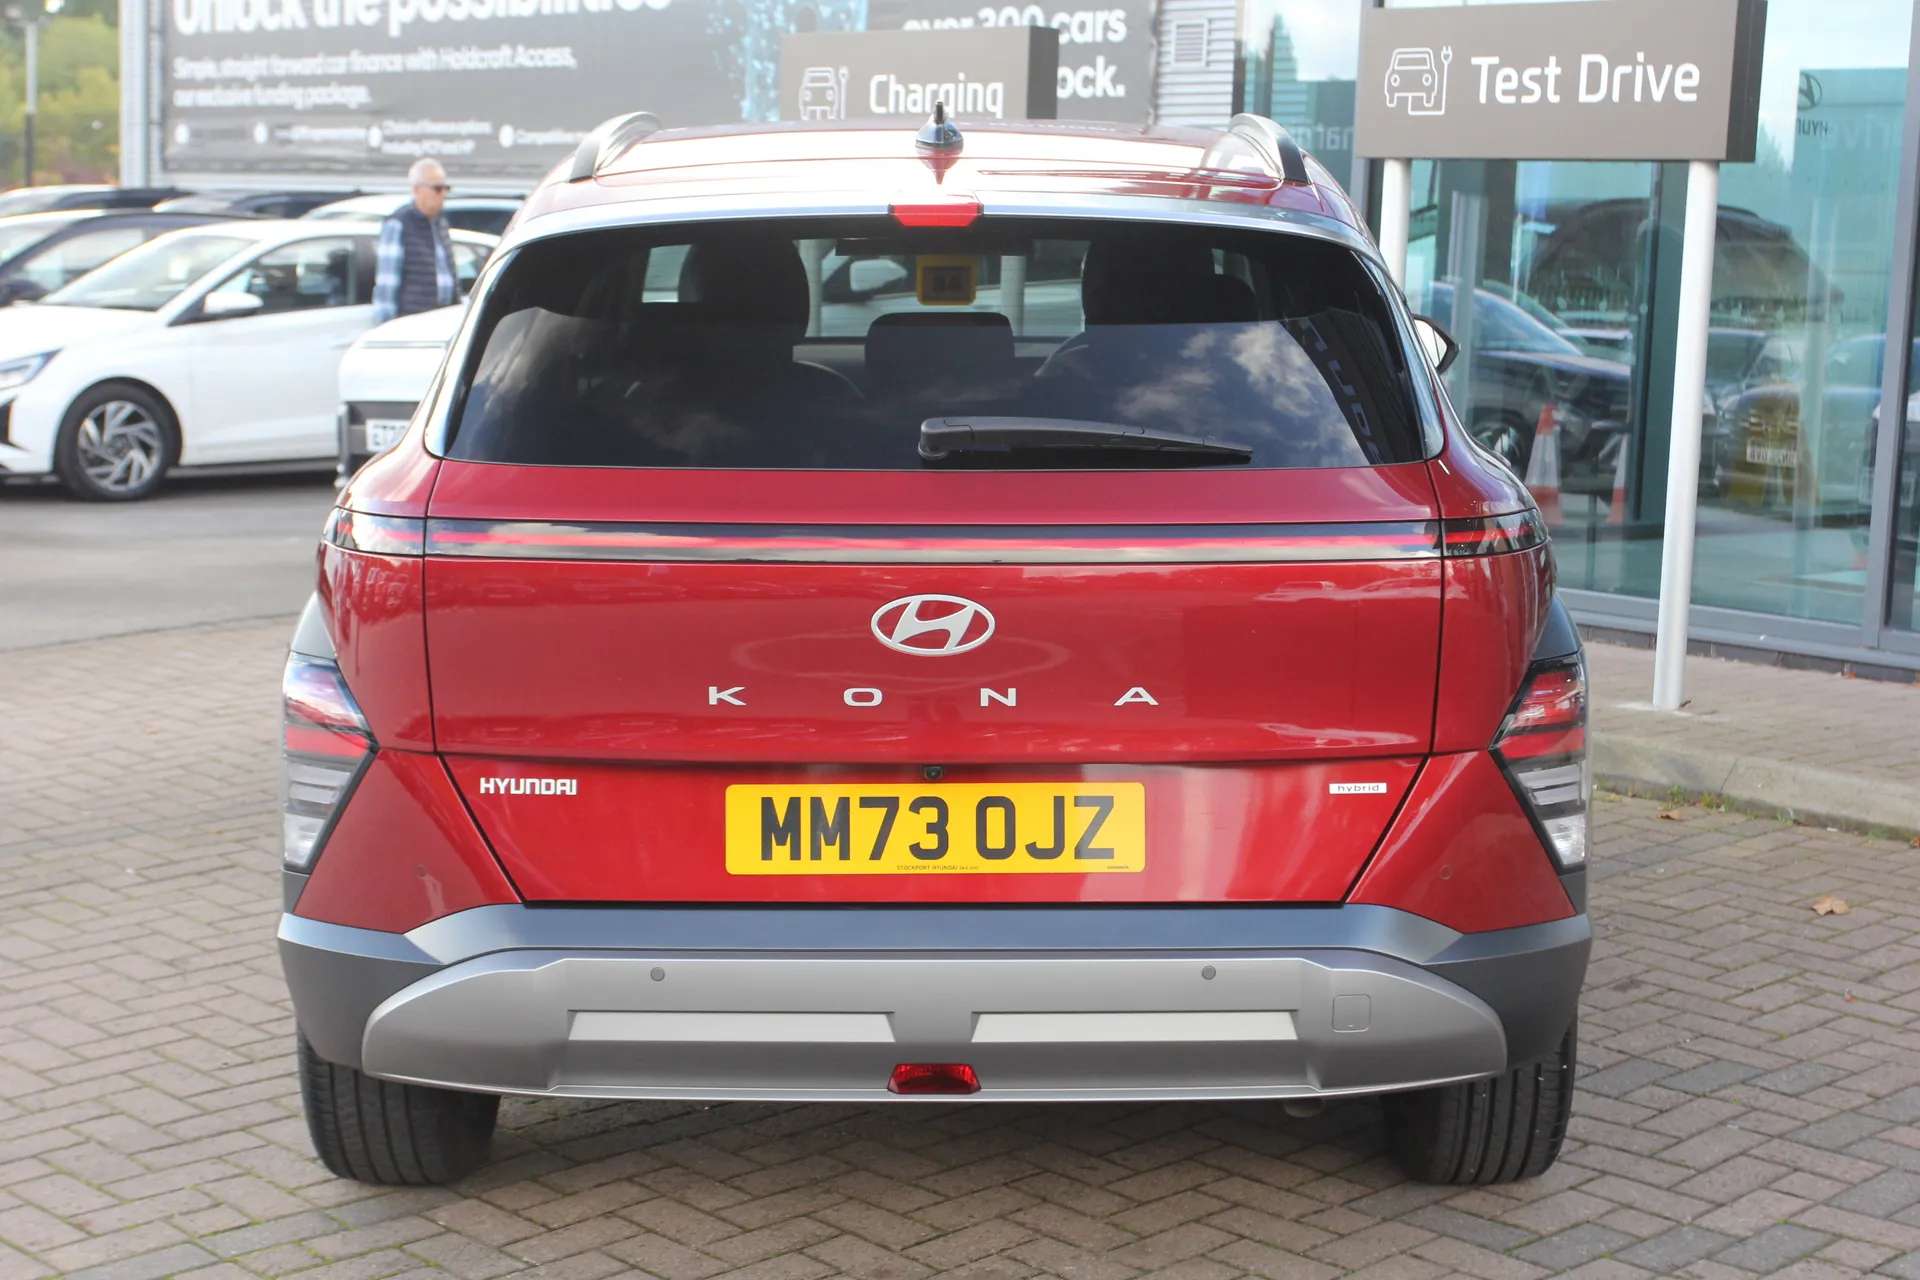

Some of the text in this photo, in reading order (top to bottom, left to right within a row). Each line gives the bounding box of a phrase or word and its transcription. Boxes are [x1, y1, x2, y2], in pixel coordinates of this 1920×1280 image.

[1051, 9, 1127, 44] cars
[869, 72, 1004, 119] Charging
[1057, 55, 1126, 99] ock.
[1470, 51, 1700, 104] Test Drive
[480, 777, 577, 796] HYUNDAI
[1337, 784, 1380, 793] hybrid
[760, 795, 1115, 861] MM73 OJZ
